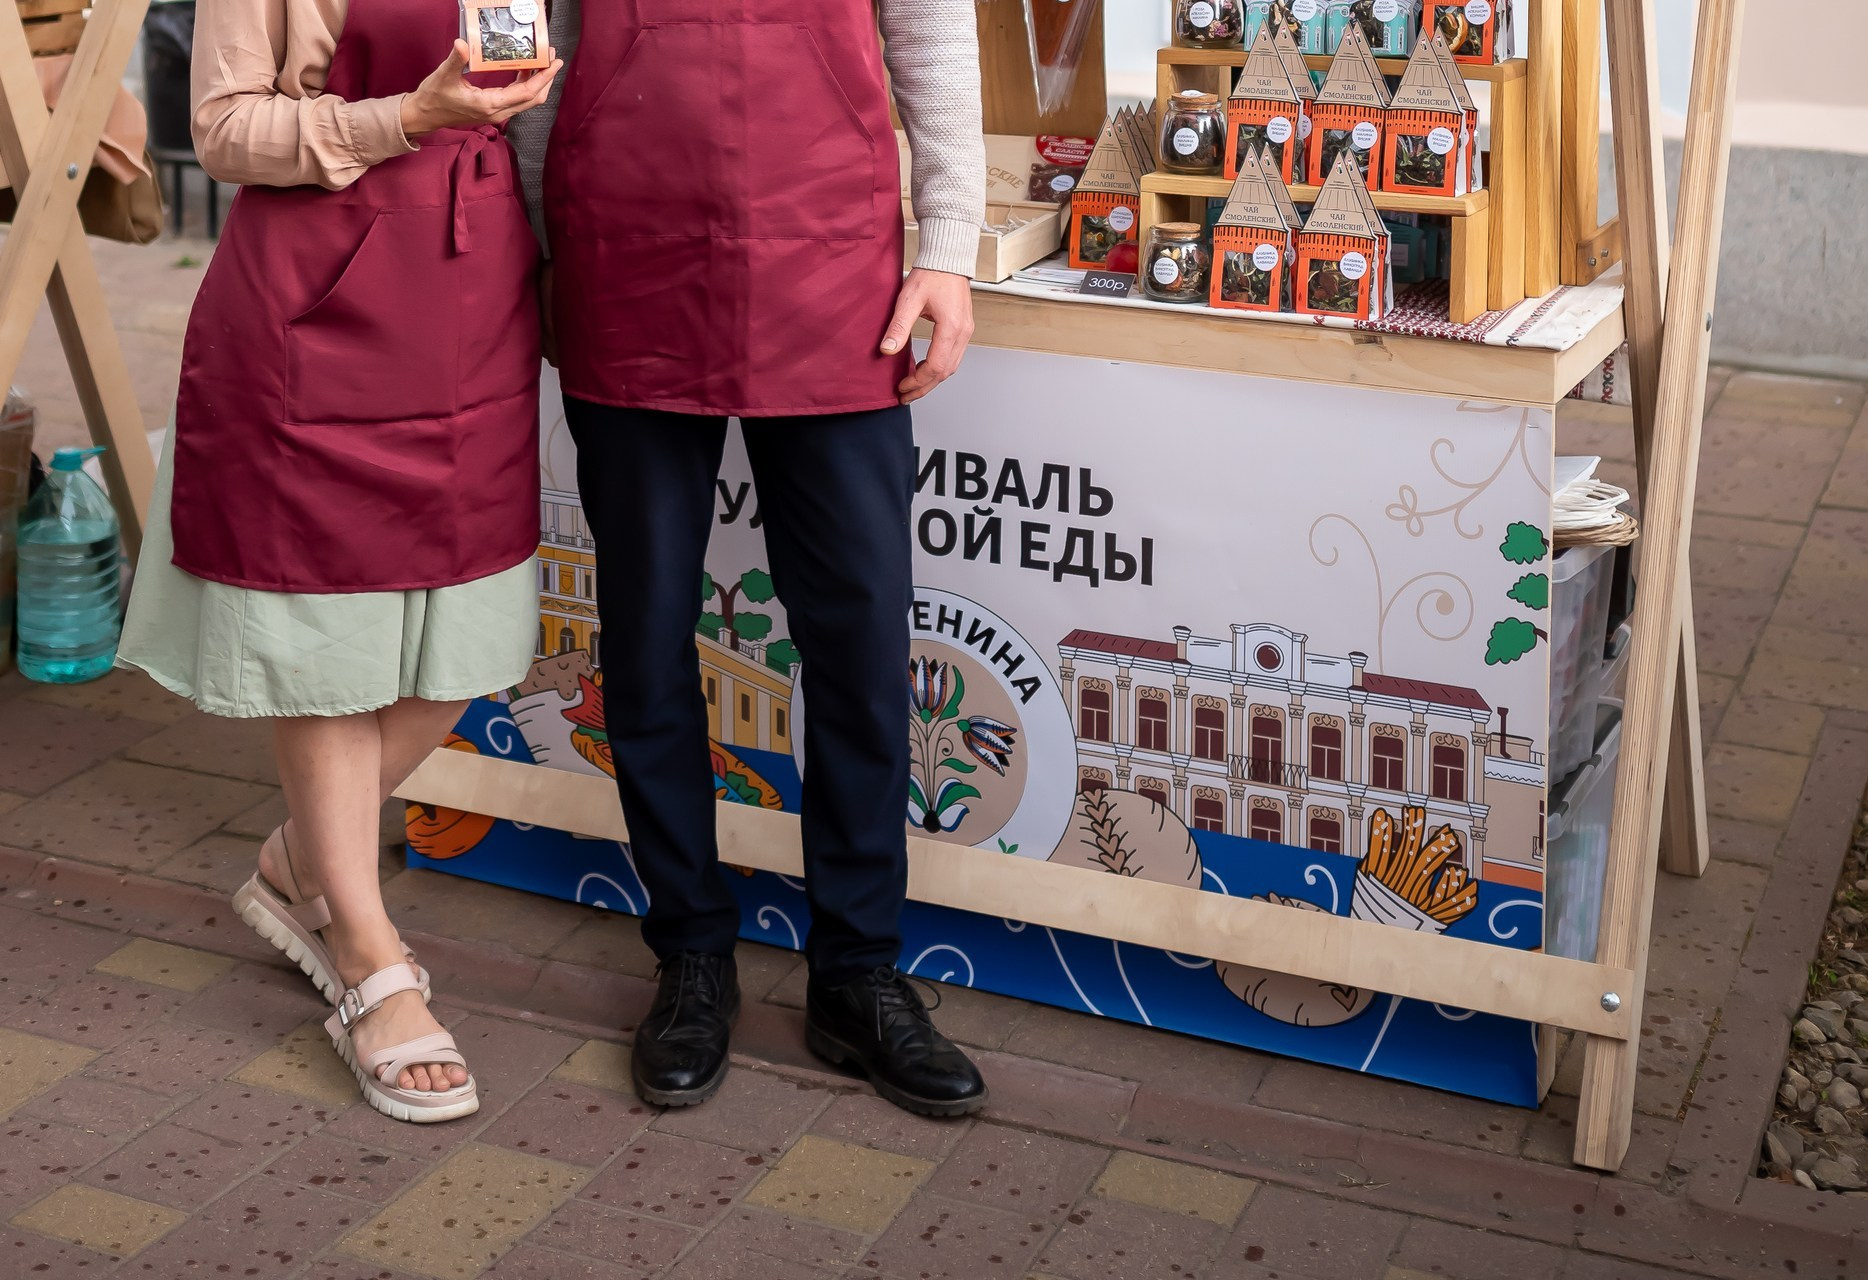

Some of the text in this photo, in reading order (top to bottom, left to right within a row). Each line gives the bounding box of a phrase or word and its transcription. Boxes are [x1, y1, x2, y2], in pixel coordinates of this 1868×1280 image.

[1239, 86, 1289, 96] СМОЛЕНСКИЙ
[1416, 89, 1432, 97] ЧАЙ
[1323, 92, 1374, 101] СМОЛЕНСКИЙ
[1397, 97, 1450, 107] СМОЛЕНСКИЙ
[1048, 141, 1095, 150] СМОЛЕНСКИ
[987, 166, 1025, 189] СКИЕ
[1100, 172, 1115, 180] ЧАЙ
[1083, 180, 1132, 190] СМОЛЕНСКИЙ
[1243, 206, 1259, 214] ЧАЙ
[1225, 214, 1276, 224] СМОЛЕНСКИЙ
[1330, 213, 1346, 221] ЧАЙ
[1310, 220, 1364, 232] СМОЛЕНСКИЙ
[1088, 277, 1128, 292] 300р.
[914, 446, 1114, 517] ИВАЛЬ
[917, 505, 1002, 565] ОЙ
[1019, 520, 1153, 588] ЕДЫ
[912, 600, 1042, 705] ЕНИНА
